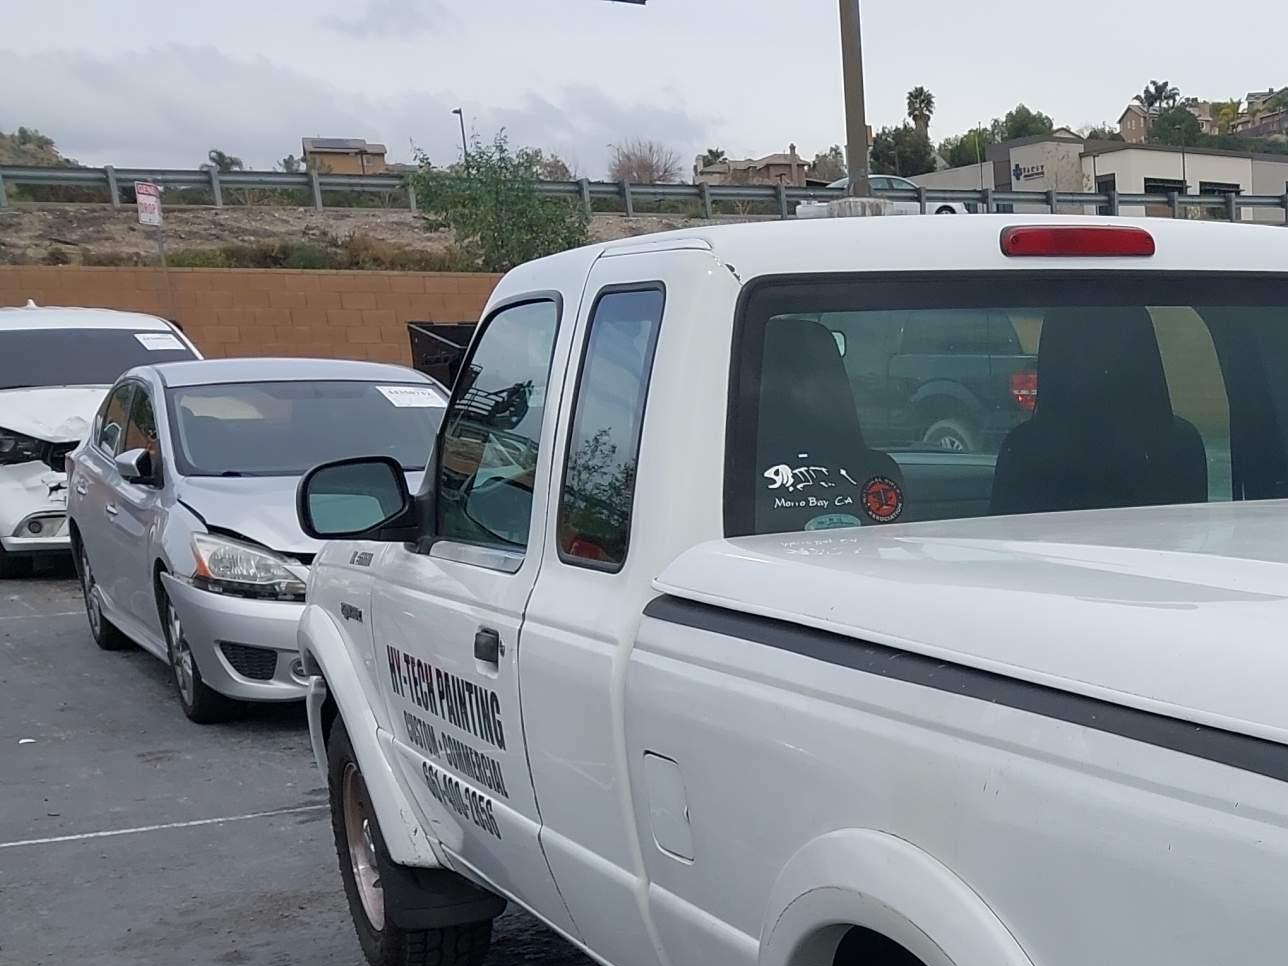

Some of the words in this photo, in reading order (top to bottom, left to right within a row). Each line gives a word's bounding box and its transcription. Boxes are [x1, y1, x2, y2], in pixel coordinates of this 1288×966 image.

[808, 496, 829, 508] Bay
[834, 496, 853, 506] CA
[387, 644, 438, 717] HY-TECH
[435, 667, 506, 751] PAINTING
[403, 709, 441, 760] CUSTOM
[441, 731, 509, 800] COMMERCIAL
[422, 761, 502, 841] 661-400-2856
